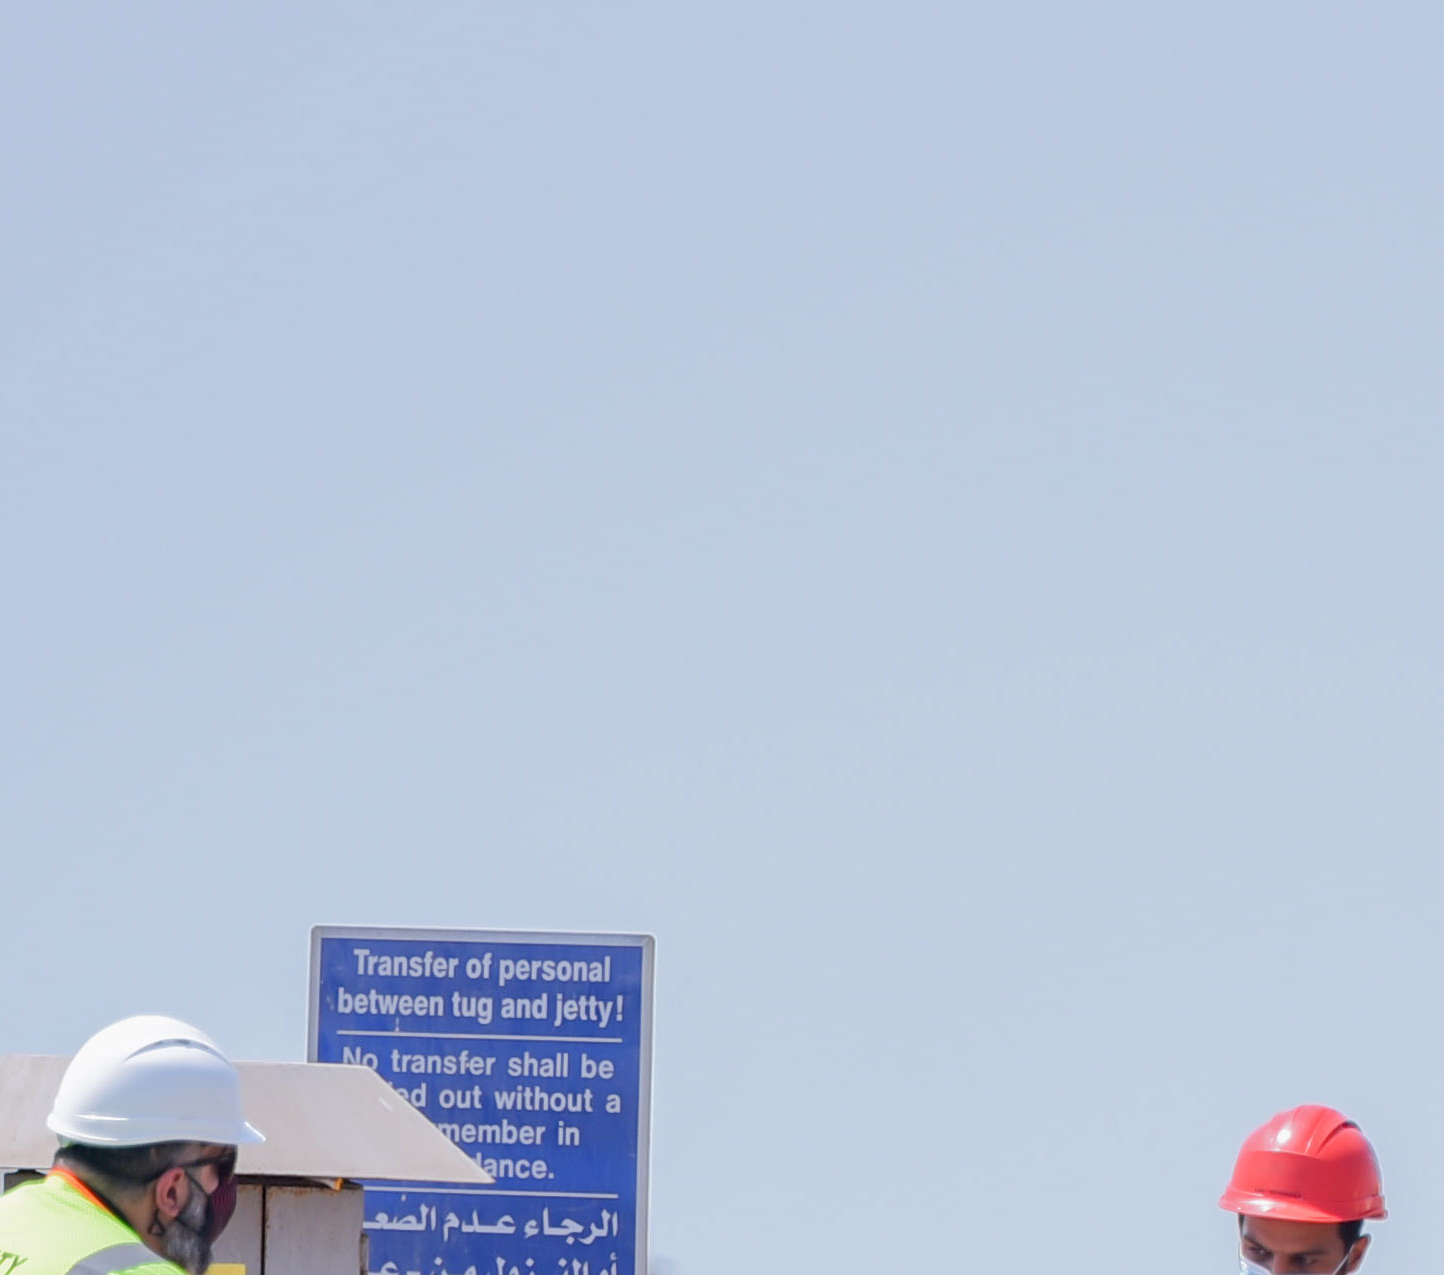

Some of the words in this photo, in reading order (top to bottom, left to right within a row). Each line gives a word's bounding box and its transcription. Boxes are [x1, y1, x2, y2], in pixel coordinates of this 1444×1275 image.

[353, 948, 459, 978] Transfer
[465, 952, 493, 979] of
[498, 955, 611, 987] personal
[337, 987, 444, 1016] between
[451, 991, 493, 1025] tug
[500, 992, 548, 1020] and
[553, 993, 624, 1028] jetty!
[390, 1049, 496, 1076] transfer
[507, 1051, 569, 1078] shall
[580, 1053, 615, 1079] be
[439, 1085, 483, 1109] out
[494, 1085, 593, 1113] without
[605, 1093, 621, 1113] a
[557, 1120, 580, 1146] in
[443, 1209, 517, 1243] عدم
[523, 1206, 618, 1245] الرجاء
